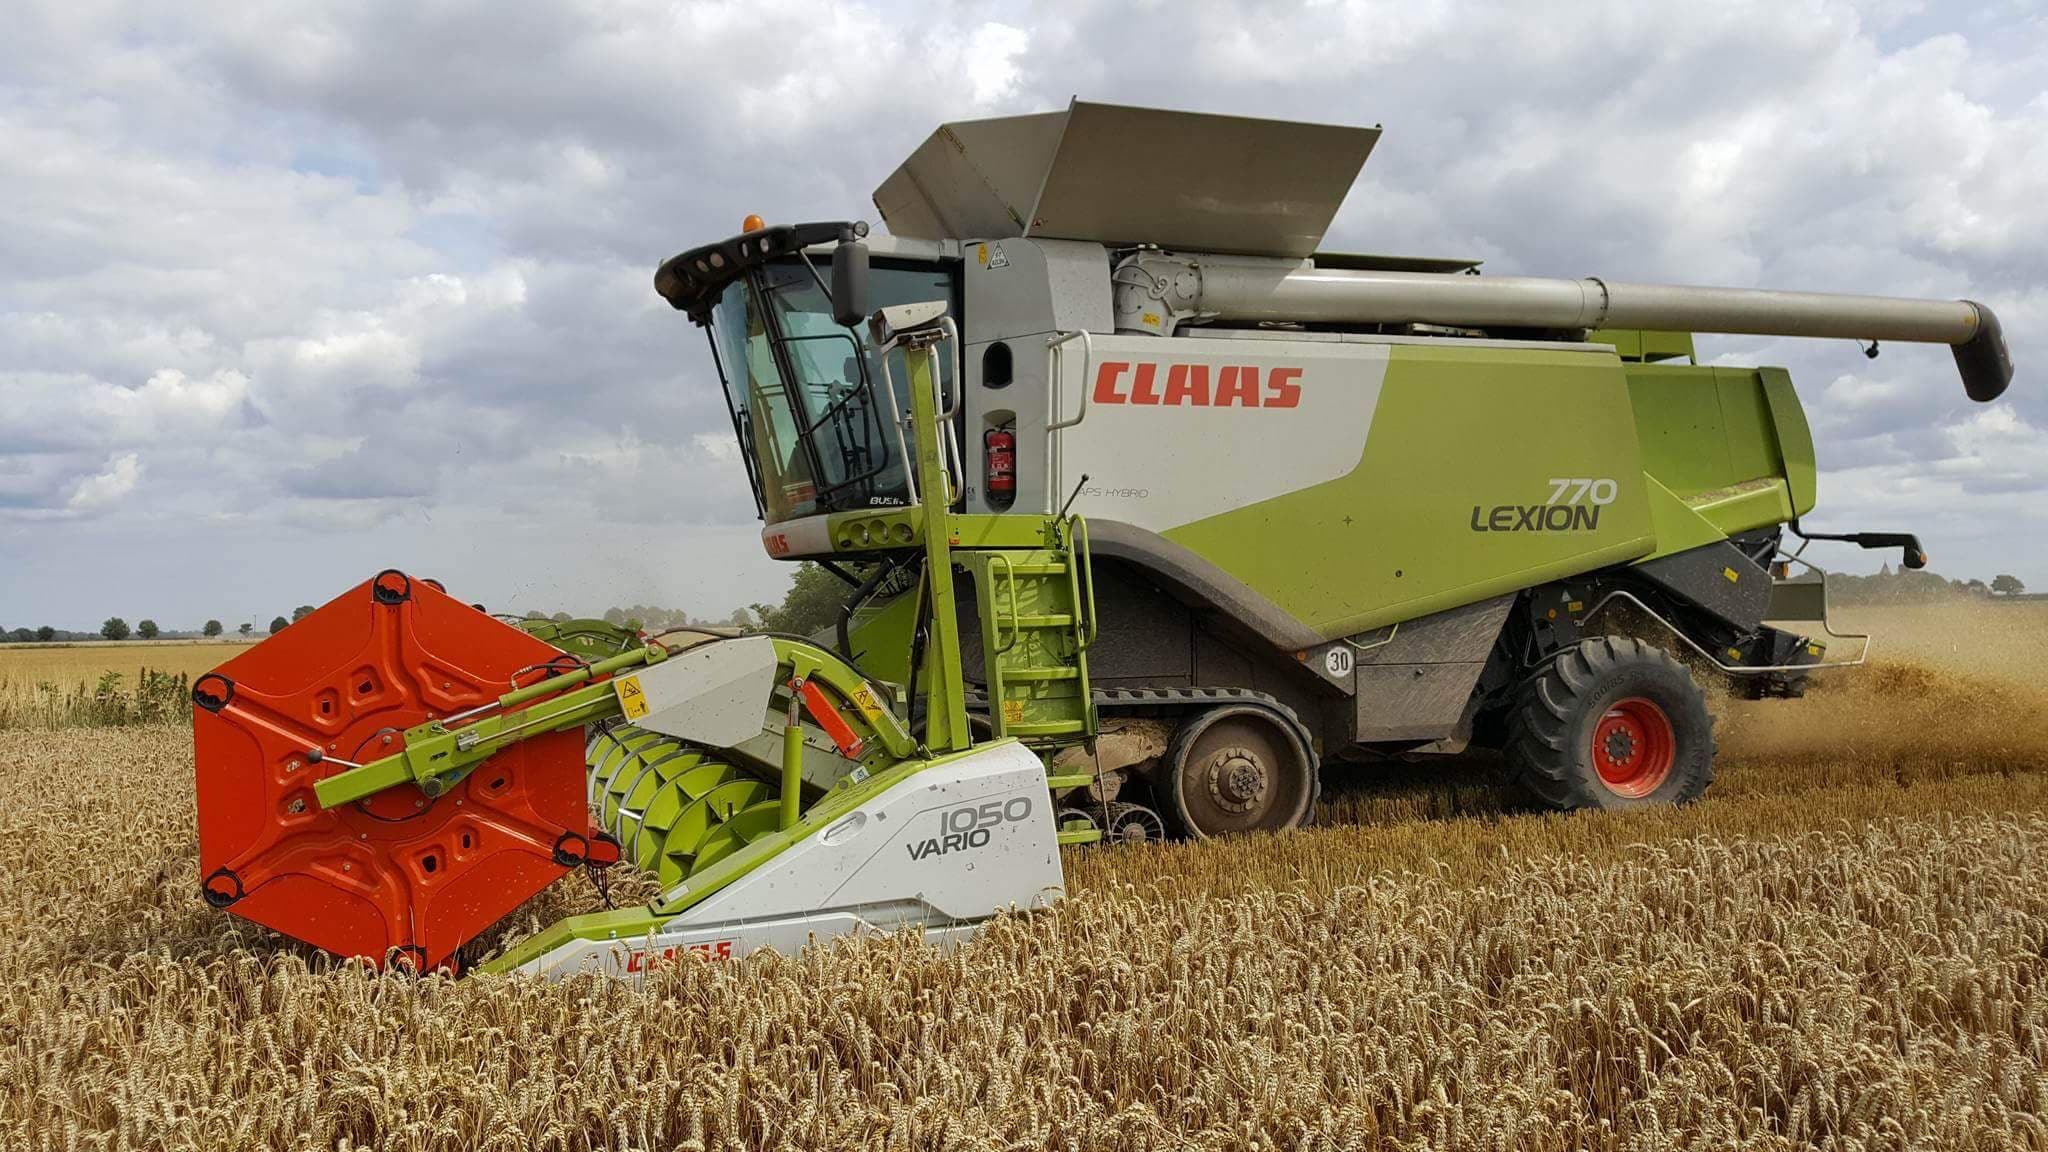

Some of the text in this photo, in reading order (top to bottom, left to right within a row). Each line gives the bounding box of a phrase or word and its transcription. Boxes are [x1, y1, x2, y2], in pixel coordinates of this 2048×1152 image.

[1093, 362, 1304, 409] CLAAS
[1079, 487, 1102, 497] APS
[1546, 478, 1618, 505] 770
[1471, 505, 1600, 532] LEXION
[1330, 652, 1348, 672] 30
[940, 797, 1032, 836] 1050
[906, 828, 990, 861] VARIO
